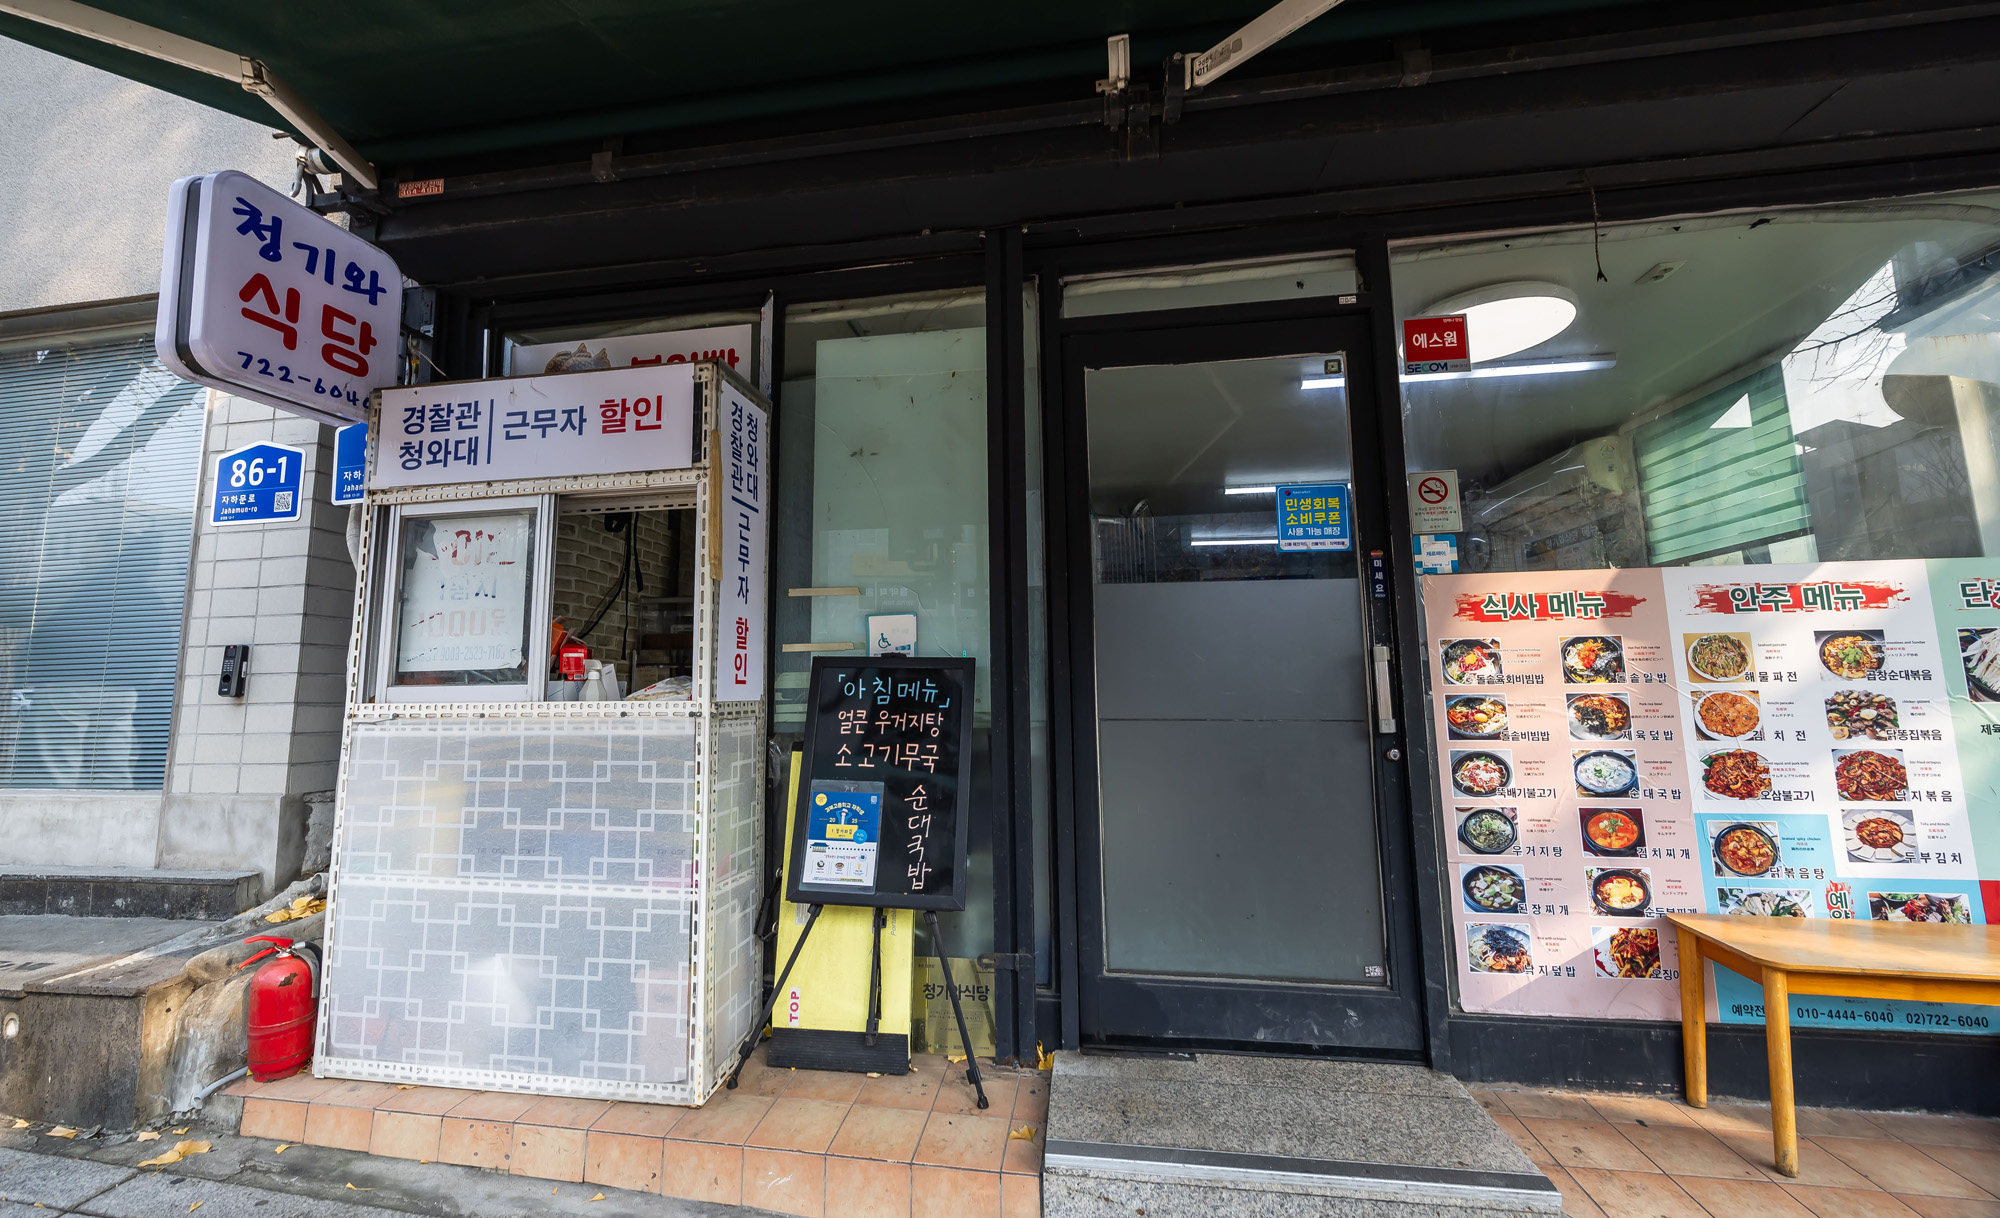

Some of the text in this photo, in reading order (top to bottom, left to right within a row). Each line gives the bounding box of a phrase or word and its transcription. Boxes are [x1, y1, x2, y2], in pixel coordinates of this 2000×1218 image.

[232, 196, 388, 306] 청기와
[239, 272, 378, 378] 식당
[1412, 331, 1457, 349] 에스원
[1407, 361, 1449, 374] SECOM
[237, 351, 370, 410] 722-6040
[402, 399, 482, 434] 경찰관
[503, 395, 663, 441] 근무자 할인
[398, 435, 480, 471] 청와대
[731, 400, 743, 494] 경찰관
[747, 412, 759, 503] 청와대
[230, 455, 287, 488] 86-1
[343, 470, 365, 481] 자하
[221, 493, 256, 505] 자하문로
[1285, 497, 1340, 511] 민생회복
[220, 506, 258, 515] Jahamun-ro
[1286, 511, 1341, 525] 소비쿠폰
[1288, 526, 1341, 536] 사용 가능 매장
[1373, 559, 1385, 593] 미세요
[734, 512, 751, 685] 근무자 할인
[1729, 584, 1865, 613] 안주 메뉴
[1482, 592, 1606, 620] 식사 메뉴
[1616, 672, 1667, 683] 돌솥알밥
[1744, 671, 1798, 682] 해물파전
[1866, 669, 1932, 681] 곱창순대볶음
[838, 709, 944, 737] 얼큰 우거지탕
[1501, 731, 1550, 741] 돌솥비빔밥
[1622, 730, 1673, 741] 제육덮밥
[1752, 730, 1806, 741] 김치전
[1886, 729, 1942, 741] 닭똥집볶음
[835, 743, 940, 774] 소고기무국
[1497, 788, 1557, 799] 뚝배기불고기
[1630, 788, 1681, 799] 순대국밥
[1760, 790, 1815, 802] 오삼불고기
[1895, 790, 1952, 802] 낙지볶음
[904, 784, 932, 890] 순대국밥
[1512, 845, 1563, 857] 우거지탕
[1637, 847, 1690, 859] 김치찌개
[1905, 852, 1962, 864] 두부김치
[1770, 867, 1824, 880] 닭볶음탕
[1518, 903, 1569, 915] 된장찌개
[1524, 964, 1576, 978] 낙지덮밥
[790, 991, 799, 1023] TOP
[1797, 1007, 1989, 1028] 010-4444-6040 02)722-6040
